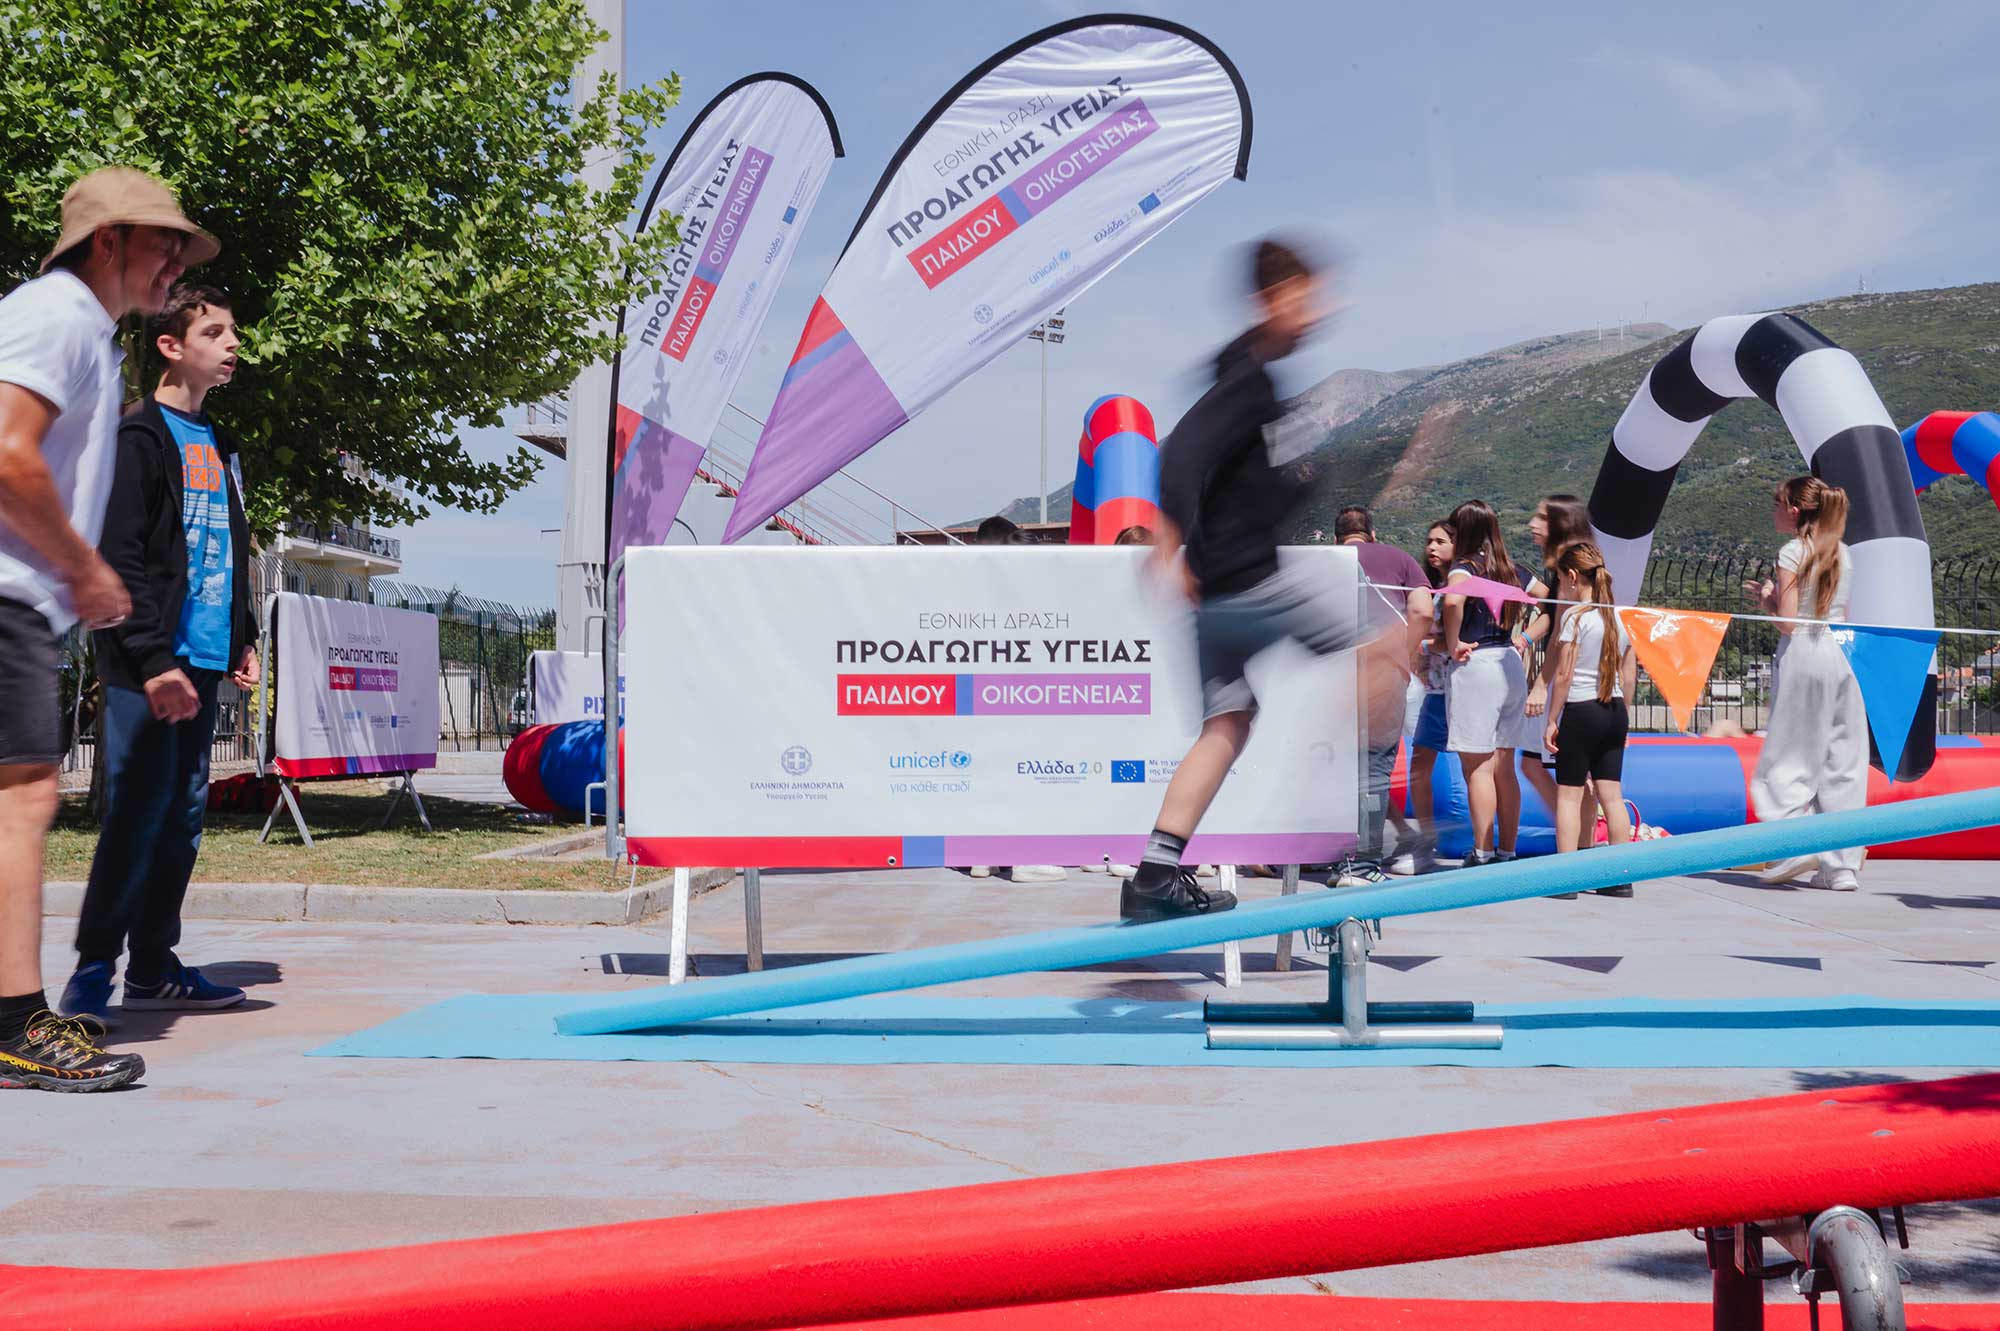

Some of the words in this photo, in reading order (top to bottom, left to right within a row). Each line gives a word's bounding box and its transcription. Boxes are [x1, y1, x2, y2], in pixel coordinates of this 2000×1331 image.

[933, 127, 999, 177] ΕΘΝΙΚΗ
[999, 92, 1055, 136] ΔΡΑΣΗ
[887, 131, 1045, 248] ΠΡΟΑΓΩΓΗΣ
[1041, 76, 1132, 138] ΥΓΕΙΑΣ
[921, 208, 1002, 275] ΠΑΙΔΙΟΥ
[1025, 110, 1148, 201] ΟΙΚΟΓΕΝΕΙΑΣ
[640, 215, 707, 347] ΠΡΟΑΓΩΓΗΣ
[697, 138, 742, 211] ΥΓΕΙΑΣ
[669, 285, 707, 354] ΠΑΙΔΙΟΥ
[709, 154, 765, 265] ΟΙΚΟΓΕΝΕΙΑΣ
[919, 612, 996, 630] ΕΘΝΙΚΗ
[1004, 612, 1070, 630] ΔΡΑΣΗ
[328, 647, 374, 663] ΠΡΟΑΓΩΓΗΣ
[375, 650, 398, 665] ΥΓΕΙΑΣ
[837, 639, 1032, 664] ΠΡΟΑΓΩΓΗΣ
[1042, 639, 1151, 664] ΥΓΕΙΑΣ
[846, 685, 946, 705] ΠΑΙΔΙΟΥ
[981, 684, 1144, 705] ΟΙΚΟΓΕΝΕΙΑΣ
[889, 751, 947, 769] unicef
[1017, 760, 1075, 775] Ελλάδα
[1079, 761, 1103, 775] 2.0
[750, 782, 789, 790] ΕΛΛΗΝΙΚΗ
[791, 782, 845, 790] ΔΗΜΟΚΡΑΤΙΑ
[890, 782, 907, 794] για
[911, 781, 939, 793] κάθε
[942, 780, 970, 793] παιδί
